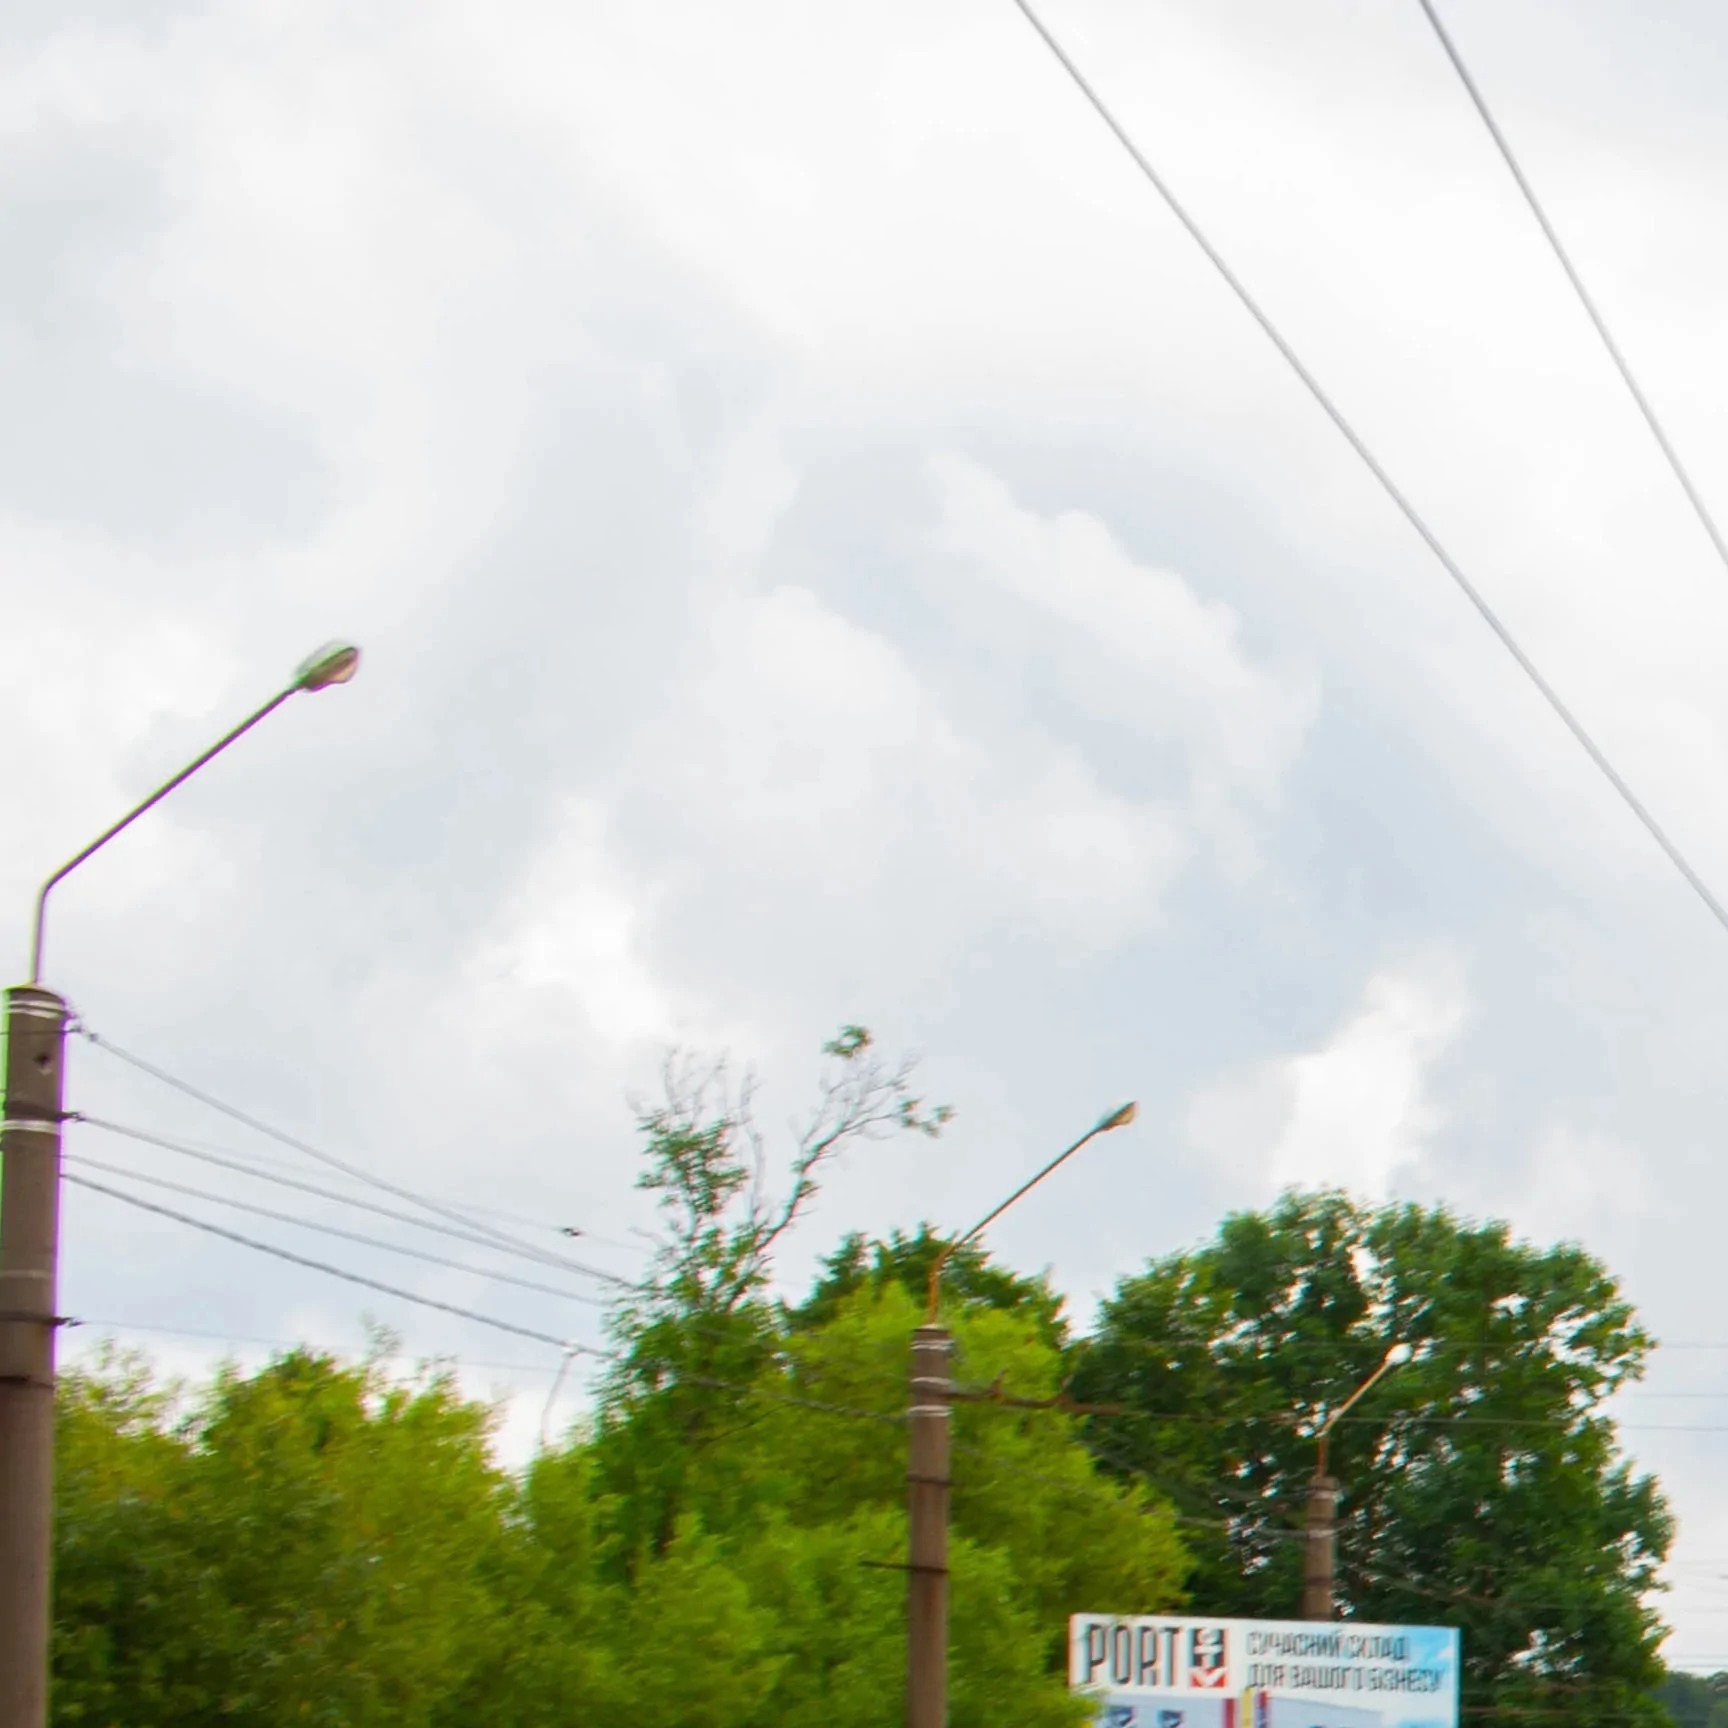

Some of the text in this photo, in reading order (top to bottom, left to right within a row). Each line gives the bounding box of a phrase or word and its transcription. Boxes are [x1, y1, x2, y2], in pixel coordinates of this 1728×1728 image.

[1084, 1623, 1181, 1687] PORT
[1247, 1631, 1408, 1661] СУЧАСНИЙ СКЛАД
[1248, 1663, 1441, 1693] ДЛЯ ВАШОГО БІЗНЕСУ
